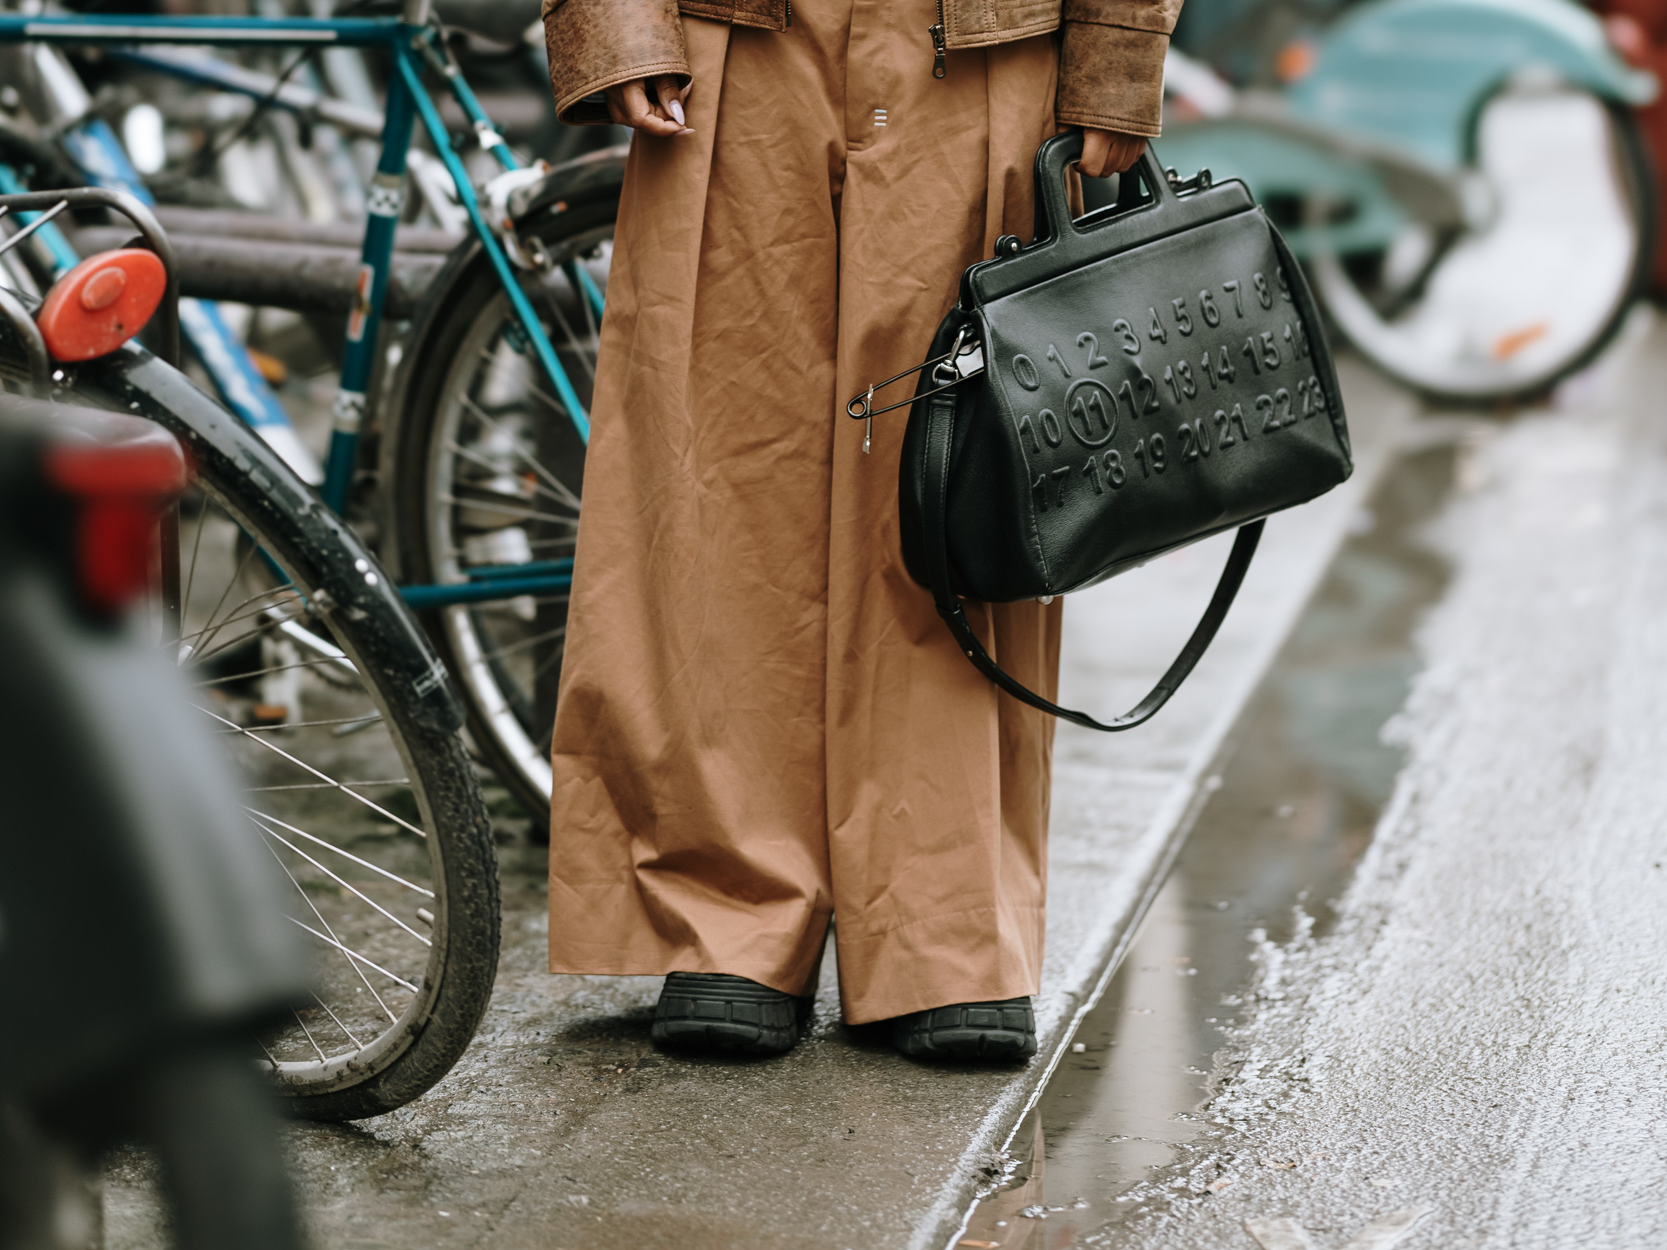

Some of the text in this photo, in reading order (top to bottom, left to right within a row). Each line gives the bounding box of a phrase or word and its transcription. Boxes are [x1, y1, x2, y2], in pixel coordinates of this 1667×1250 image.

[1012, 354, 1040, 391] 0
[1047, 342, 1072, 378] 1
[1076, 331, 1109, 370] 2
[1113, 318, 1141, 355] 3
[1149, 306, 1167, 344] 4
[1172, 297, 1193, 337] 5
[1199, 289, 1220, 328] 6
[1223, 279, 1243, 318] 7
[1253, 272, 1272, 310] 8
[1019, 408, 1062, 453] 10
[1071, 390, 1110, 436] 11
[1118, 374, 1160, 419] 12
[1164, 360, 1197, 403] 13
[1201, 345, 1235, 390] 14
[1243, 331, 1280, 375] 15
[1032, 375, 1326, 512] 17 18 19 20 21 22 23
